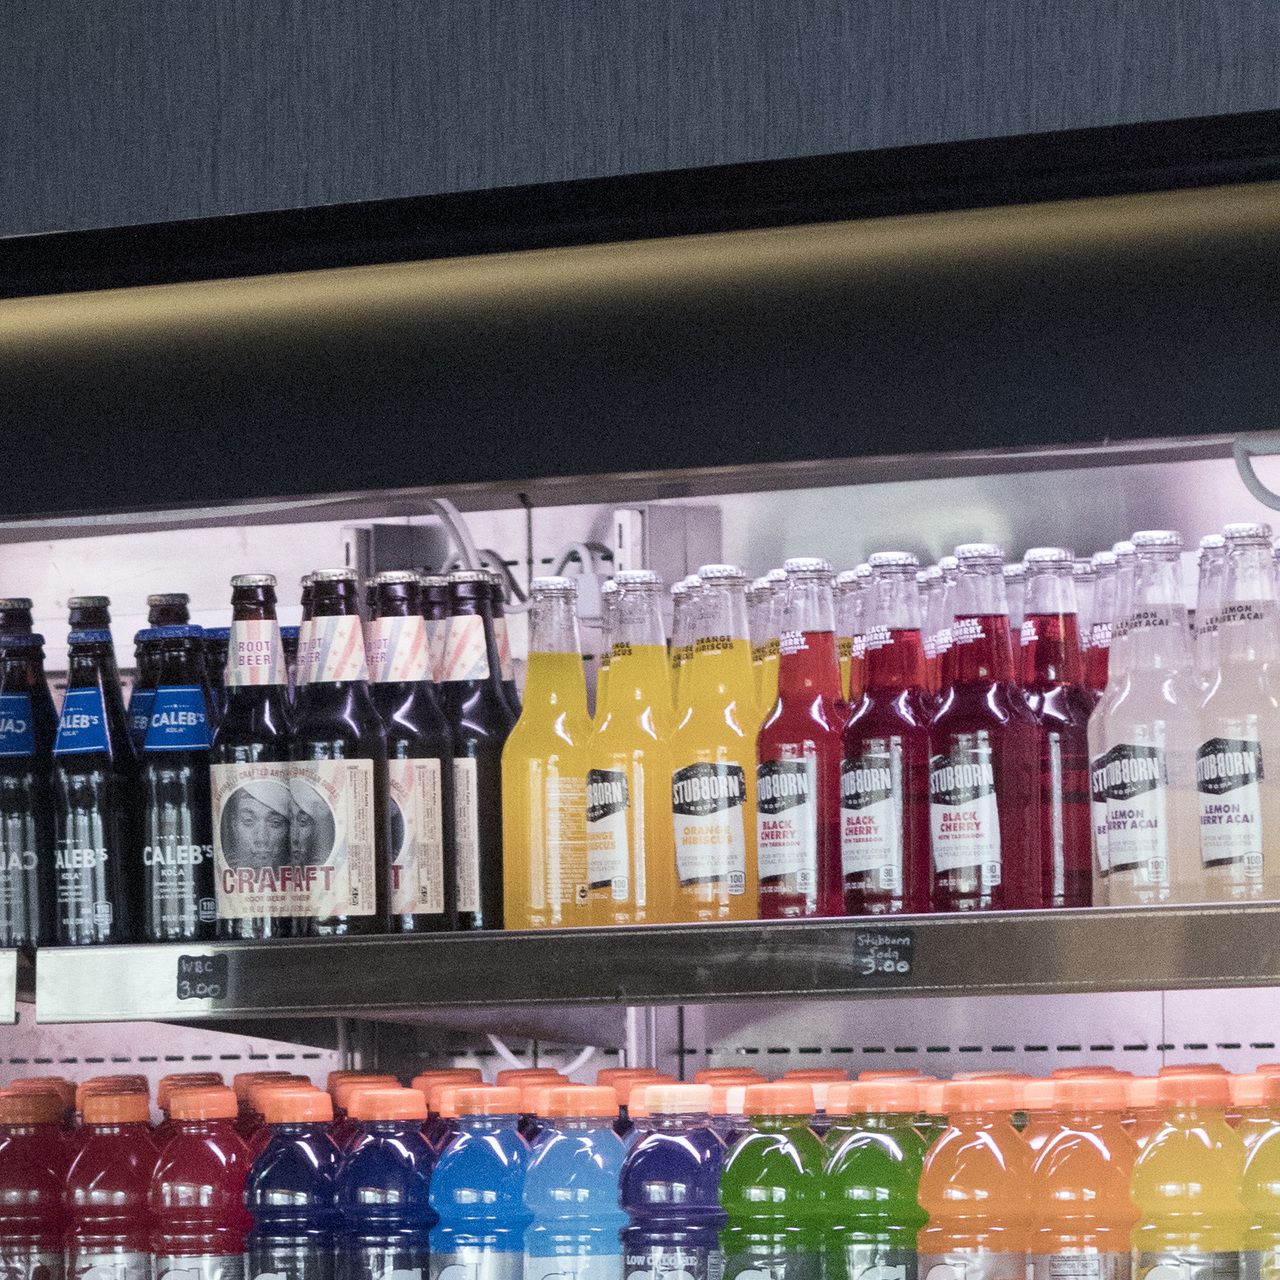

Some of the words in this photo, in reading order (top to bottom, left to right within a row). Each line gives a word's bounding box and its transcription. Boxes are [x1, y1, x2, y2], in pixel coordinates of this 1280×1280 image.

[238, 641, 271, 653] ROOT
[238, 654, 271, 666] BEER
[60, 714, 99, 729] ALEB'S
[152, 712, 205, 728] CALEB'S
[930, 763, 994, 794] STUBBORN
[672, 773, 740, 806] STUBBORN
[1111, 809, 1145, 820] LEMON
[1204, 803, 1241, 815] LEMON
[845, 815, 877, 827] BLACK
[942, 811, 978, 823] BLACK
[683, 825, 731, 837] ORANGE
[761, 819, 792, 831] BLACK
[844, 825, 879, 836] CHERRY
[939, 820, 982, 833] CHERRY
[681, 835, 733, 847] HIBISCUS
[760, 829, 796, 841] CHERRY
[55, 847, 109, 869] ALEB'S
[143, 844, 214, 867] CALEB'S
[1245, 854, 1261, 866] 100
[1149, 859, 1164, 871] 100
[222, 865, 291, 894] CRAF
[728, 873, 744, 885] 100
[856, 933, 911, 947] Stubborn
[181, 960, 214, 974] WBC
[860, 958, 910, 975] 3.00
[180, 980, 221, 999] 3.00
[626, 1255, 646, 1266] LOW
